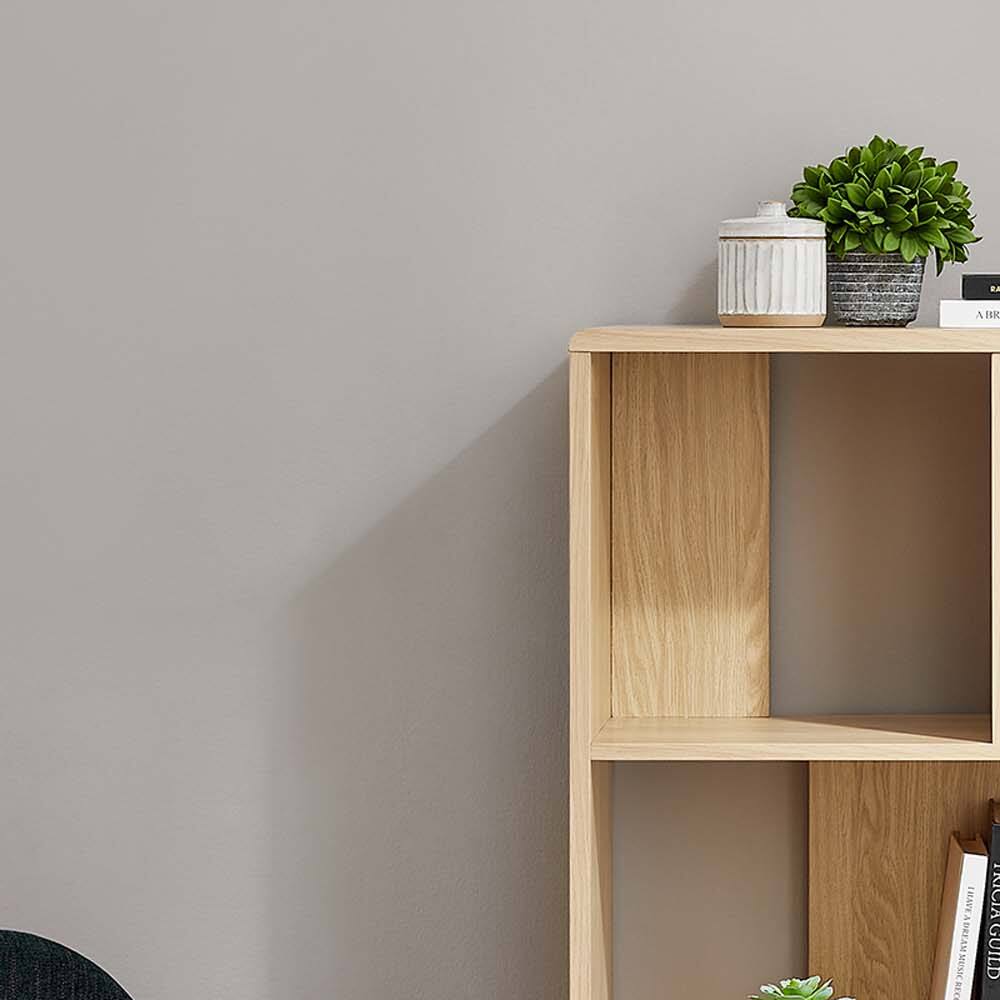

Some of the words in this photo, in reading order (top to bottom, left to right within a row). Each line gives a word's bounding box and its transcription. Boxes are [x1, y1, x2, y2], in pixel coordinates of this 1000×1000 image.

[976, 310, 985, 319] A
[960, 922, 970, 953] DREAM
[956, 953, 966, 981] MUSIC
